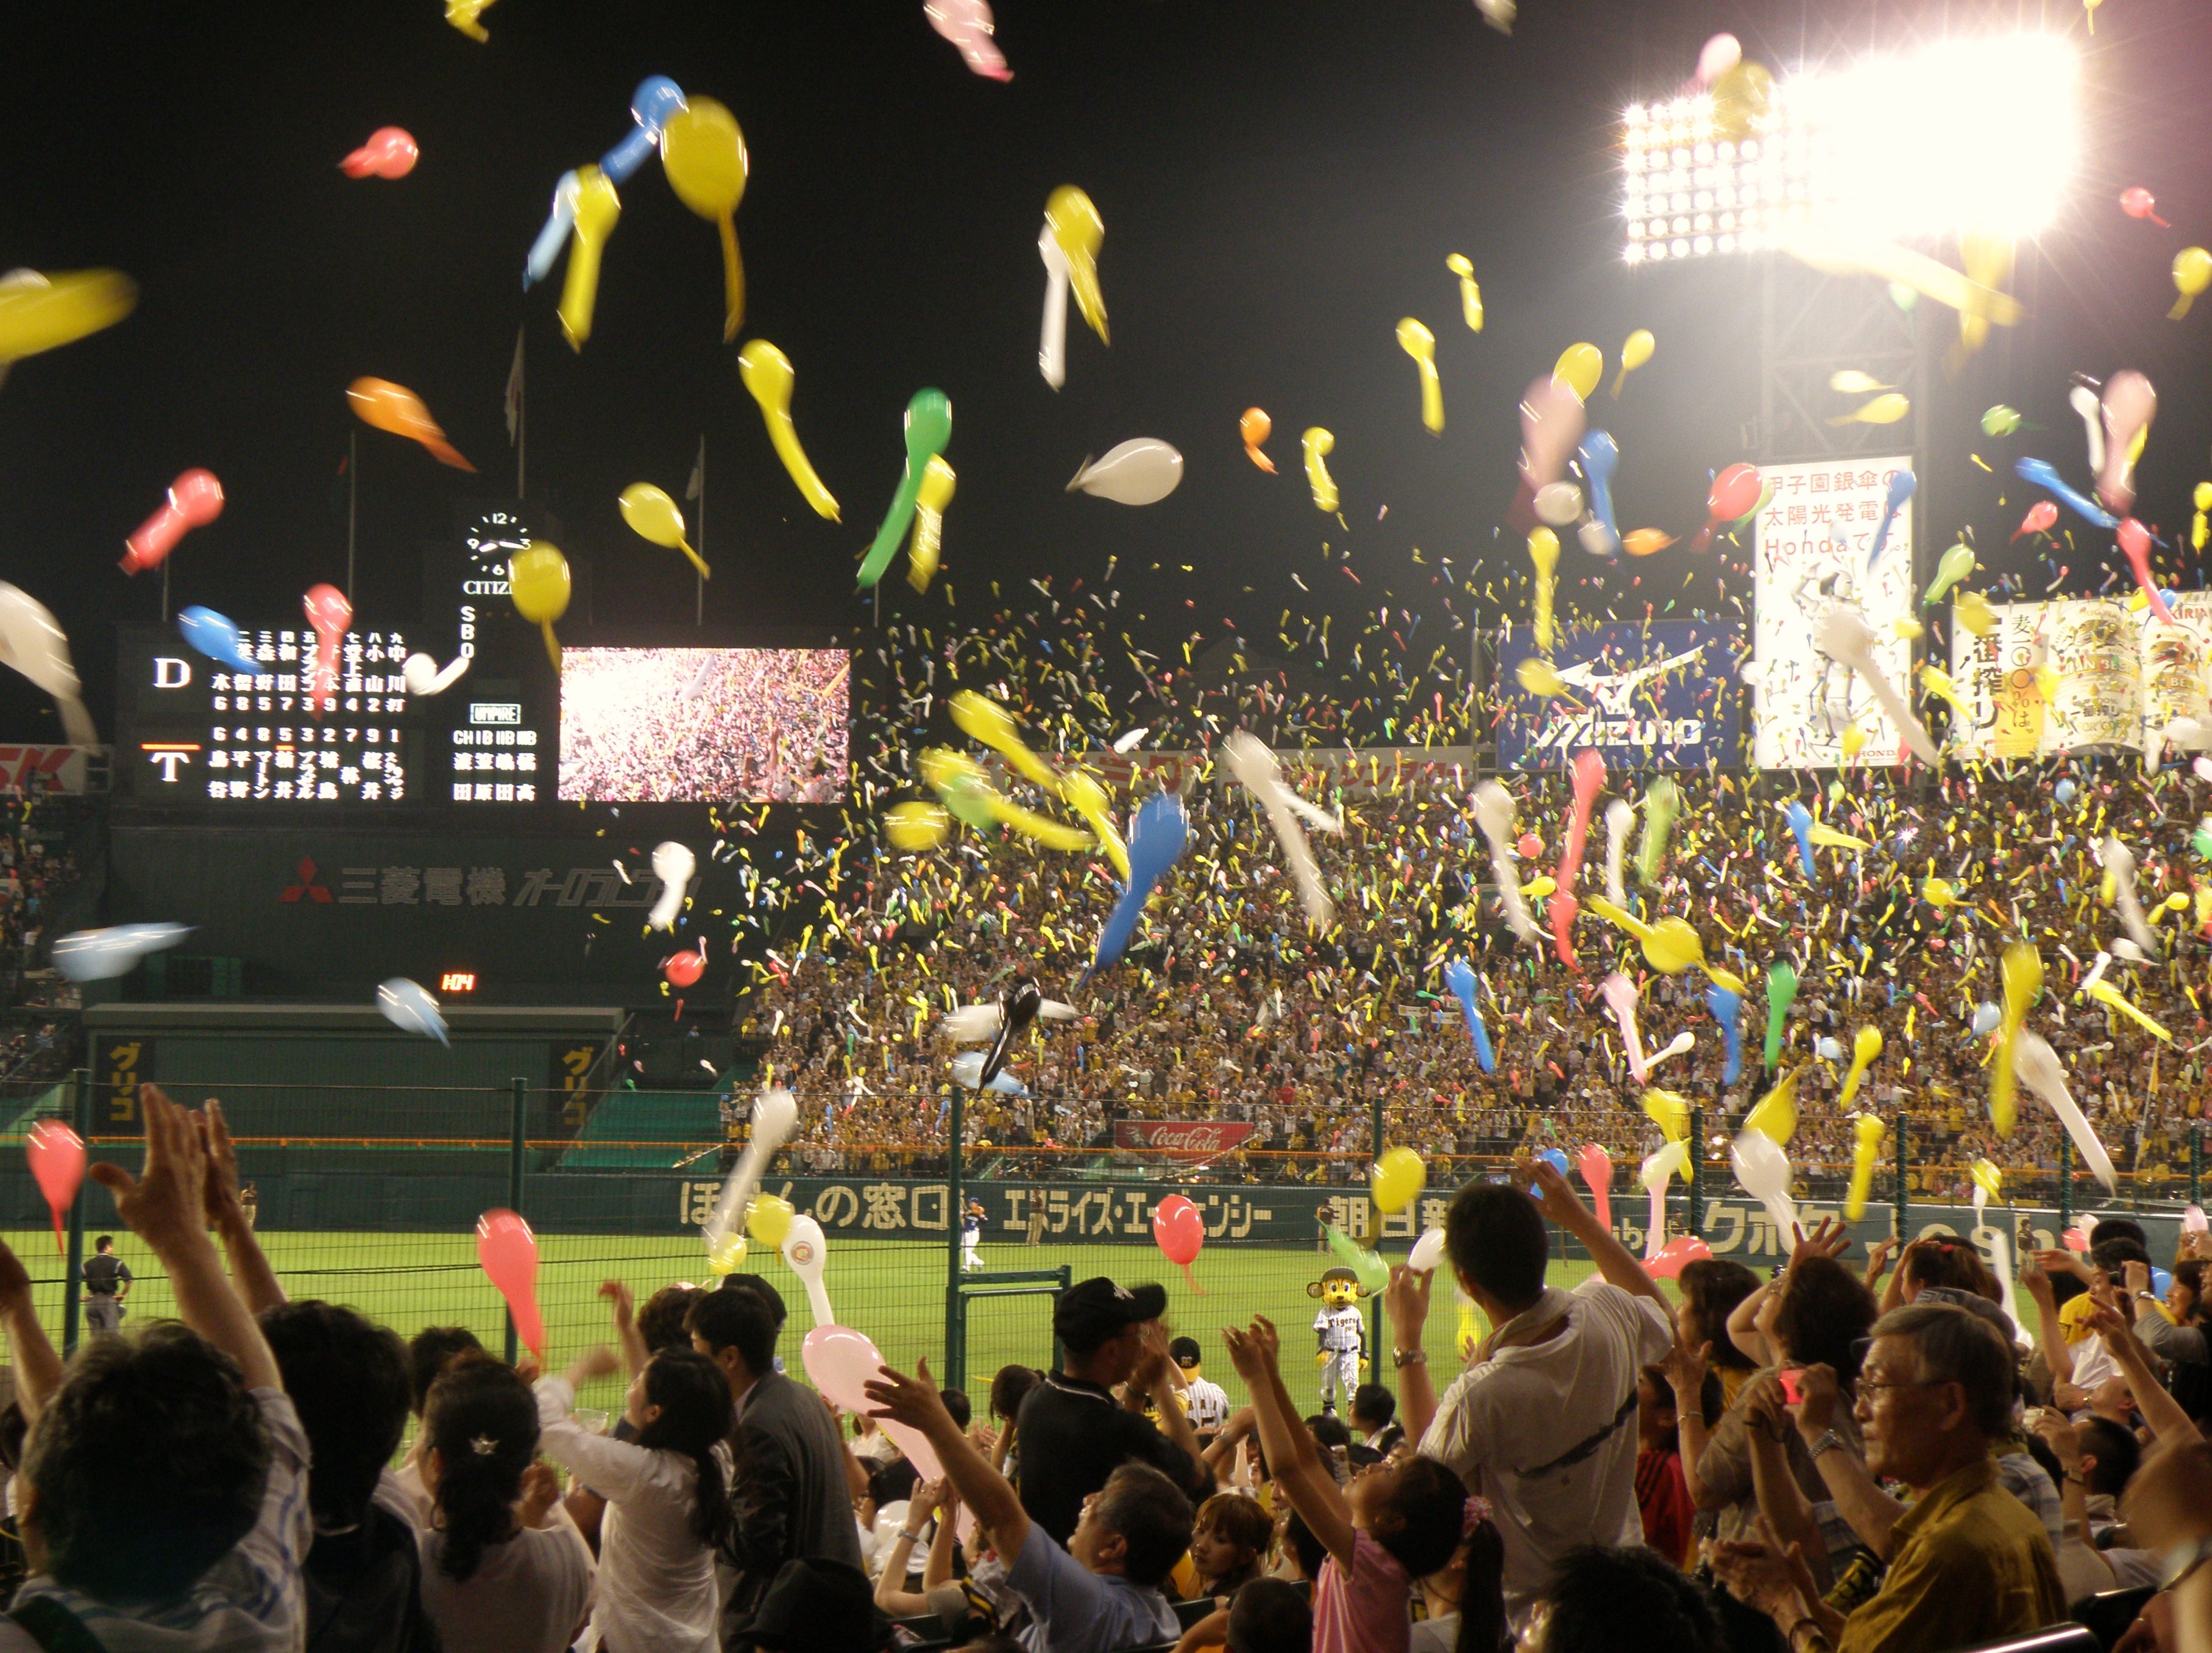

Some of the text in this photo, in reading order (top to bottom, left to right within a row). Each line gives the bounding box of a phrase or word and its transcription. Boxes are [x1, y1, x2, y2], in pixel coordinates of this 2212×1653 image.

[491, 512, 508, 525] 12
[466, 538, 532, 550] 9 3
[492, 564, 506, 576] 6
[460, 605, 476, 622] S
[460, 623, 475, 641] B
[154, 657, 193, 689] D
[215, 697, 227, 709] 6
[236, 697, 248, 710] 8
[258, 697, 270, 710] 5
[281, 697, 292, 710] 7
[302, 697, 314, 711] 3
[324, 697, 336, 711] 9
[346, 698, 357, 711] 4
[367, 698, 379, 712] 2
[474, 706, 517, 722] UMPIRE
[214, 727, 398, 742] 6 4 8 5 3 2 7 9 1
[453, 730, 474, 745] CH
[151, 752, 191, 783] T
[337, 866, 506, 906] 三菱電機
[109, 1043, 141, 1120] グリコ
[562, 1047, 594, 1125] グリコ
[1328, 1317, 1356, 1328] Tigers
